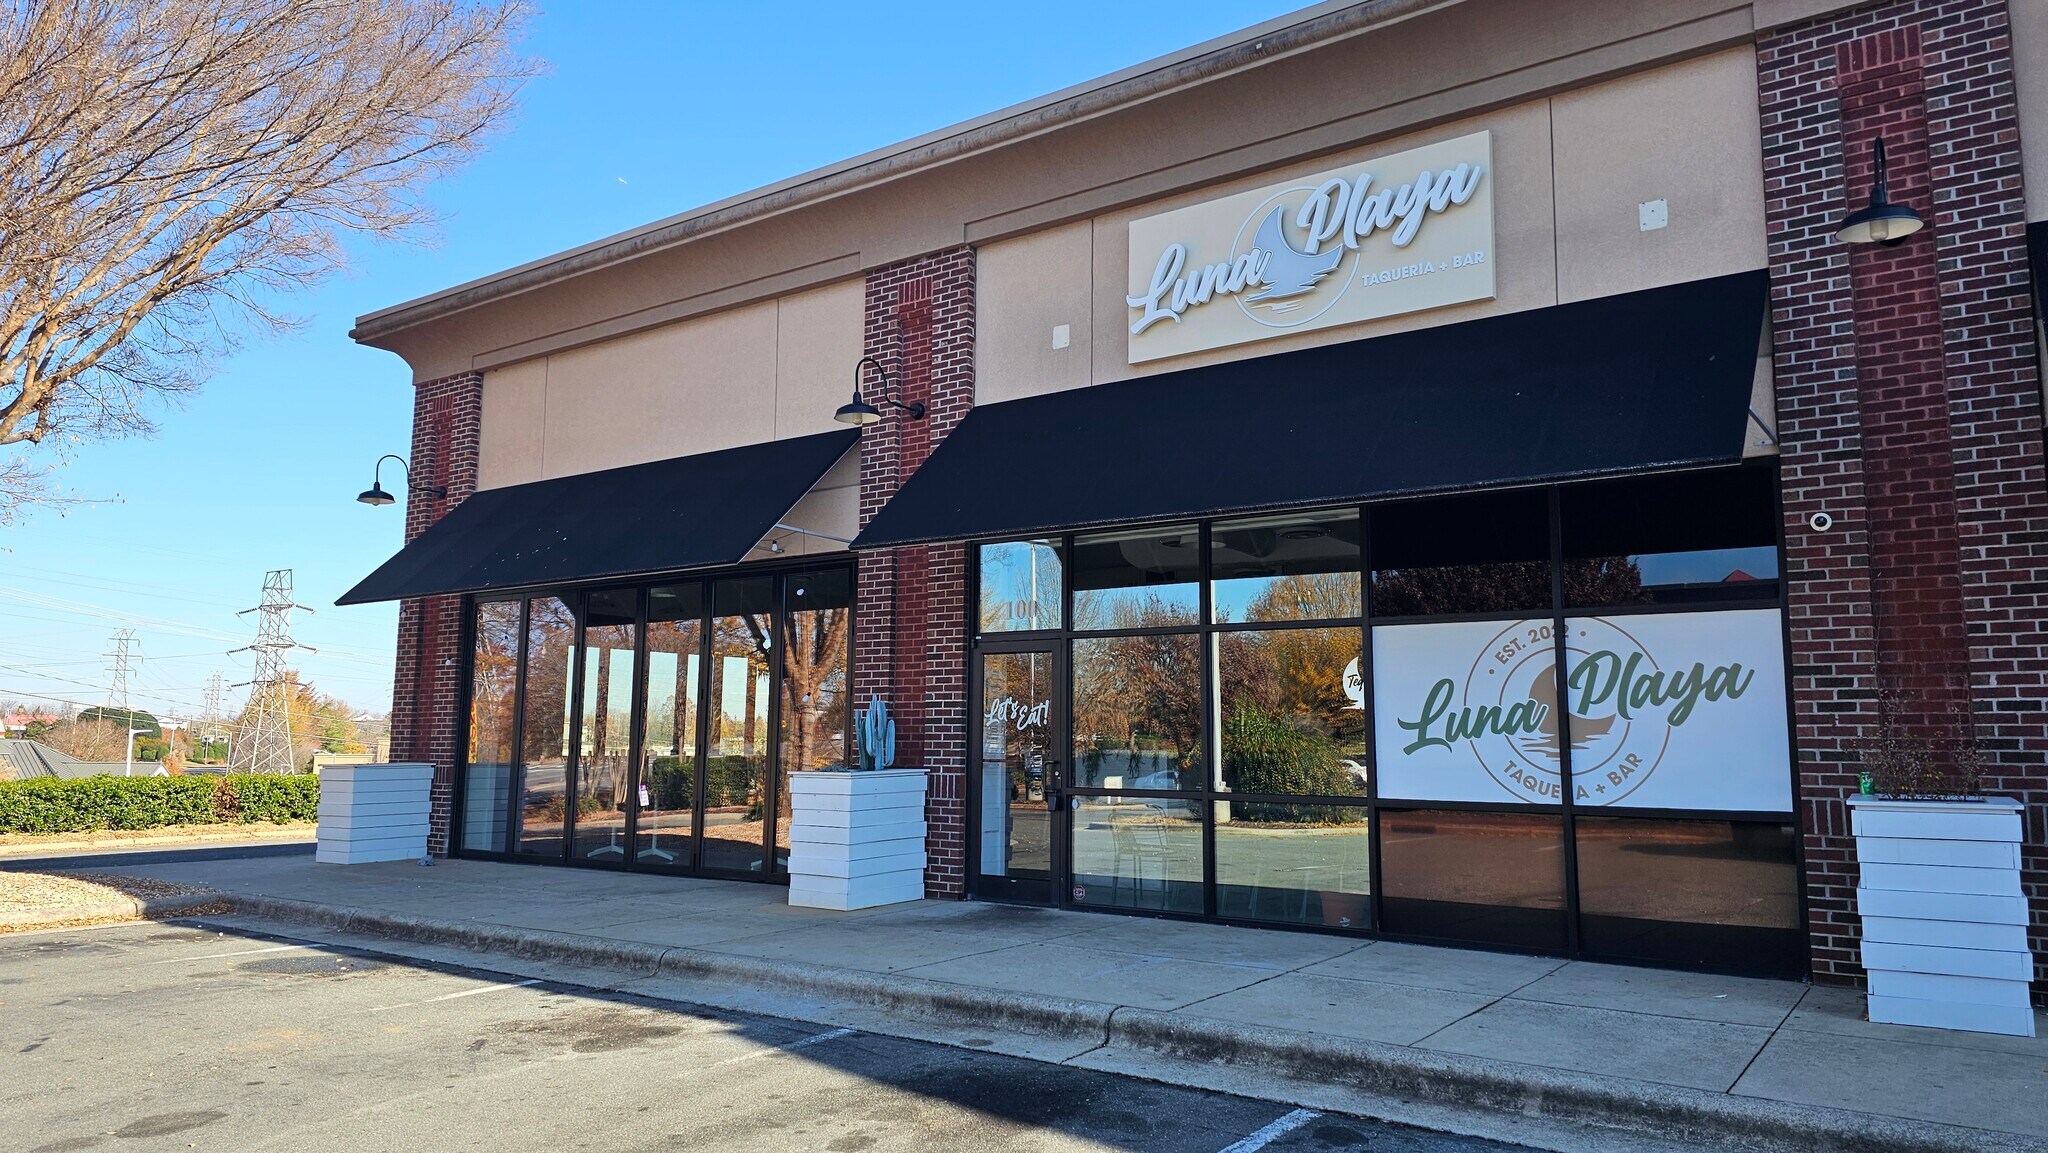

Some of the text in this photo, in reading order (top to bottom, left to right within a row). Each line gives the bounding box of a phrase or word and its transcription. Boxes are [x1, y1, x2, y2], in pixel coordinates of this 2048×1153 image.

[1126, 162, 1481, 336] Luna Playa
[1362, 261, 1435, 287] TAQUERIA
[1452, 250, 1485, 269] BAR
[1005, 600, 1038, 619] 100
[1494, 624, 1569, 665] EST. 20
[984, 696, 1049, 730] Let's Eat!
[1397, 649, 1755, 755] Luna Playa
[1503, 760, 1590, 800] TAQUEA
[1606, 753, 1643, 787] BAR
